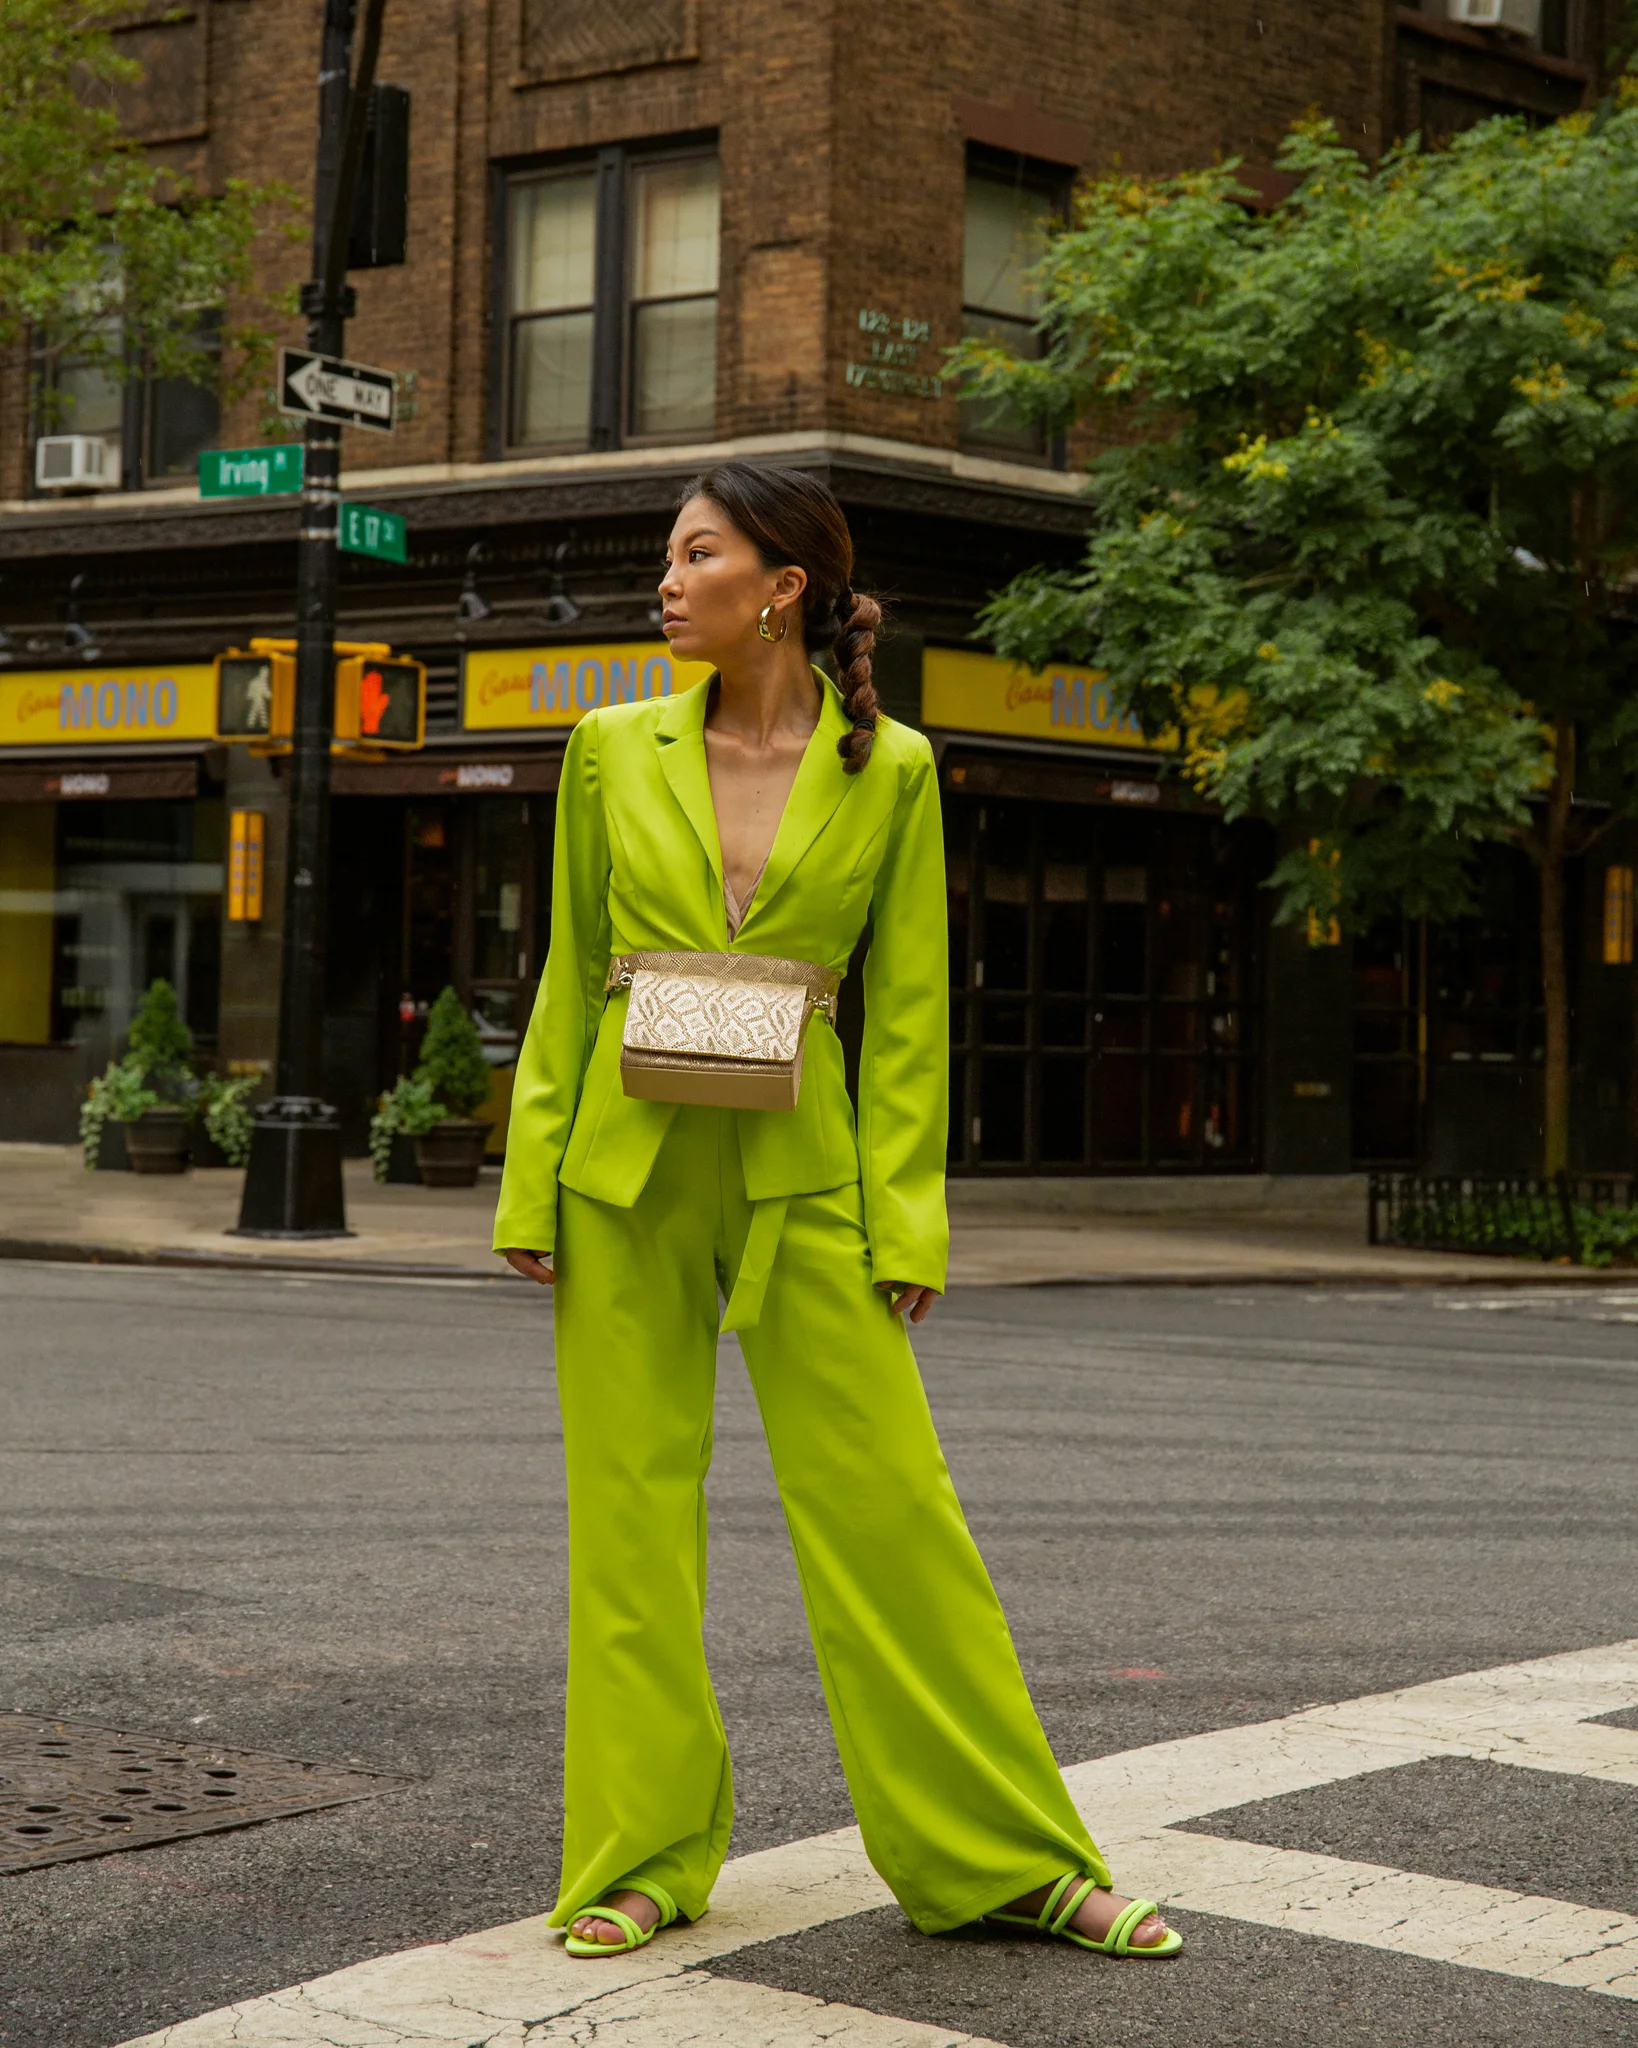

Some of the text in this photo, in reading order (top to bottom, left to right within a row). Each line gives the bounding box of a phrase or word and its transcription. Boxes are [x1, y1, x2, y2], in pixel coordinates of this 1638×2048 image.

[305, 372, 384, 407] ONE WAY
[218, 453, 269, 493] Irving
[349, 511, 361, 546] E
[364, 515, 380, 549] 17
[529, 655, 673, 713] MONO
[59, 678, 178, 730] MONO
[60, 773, 110, 795] MONO
[457, 764, 514, 787] MONO
